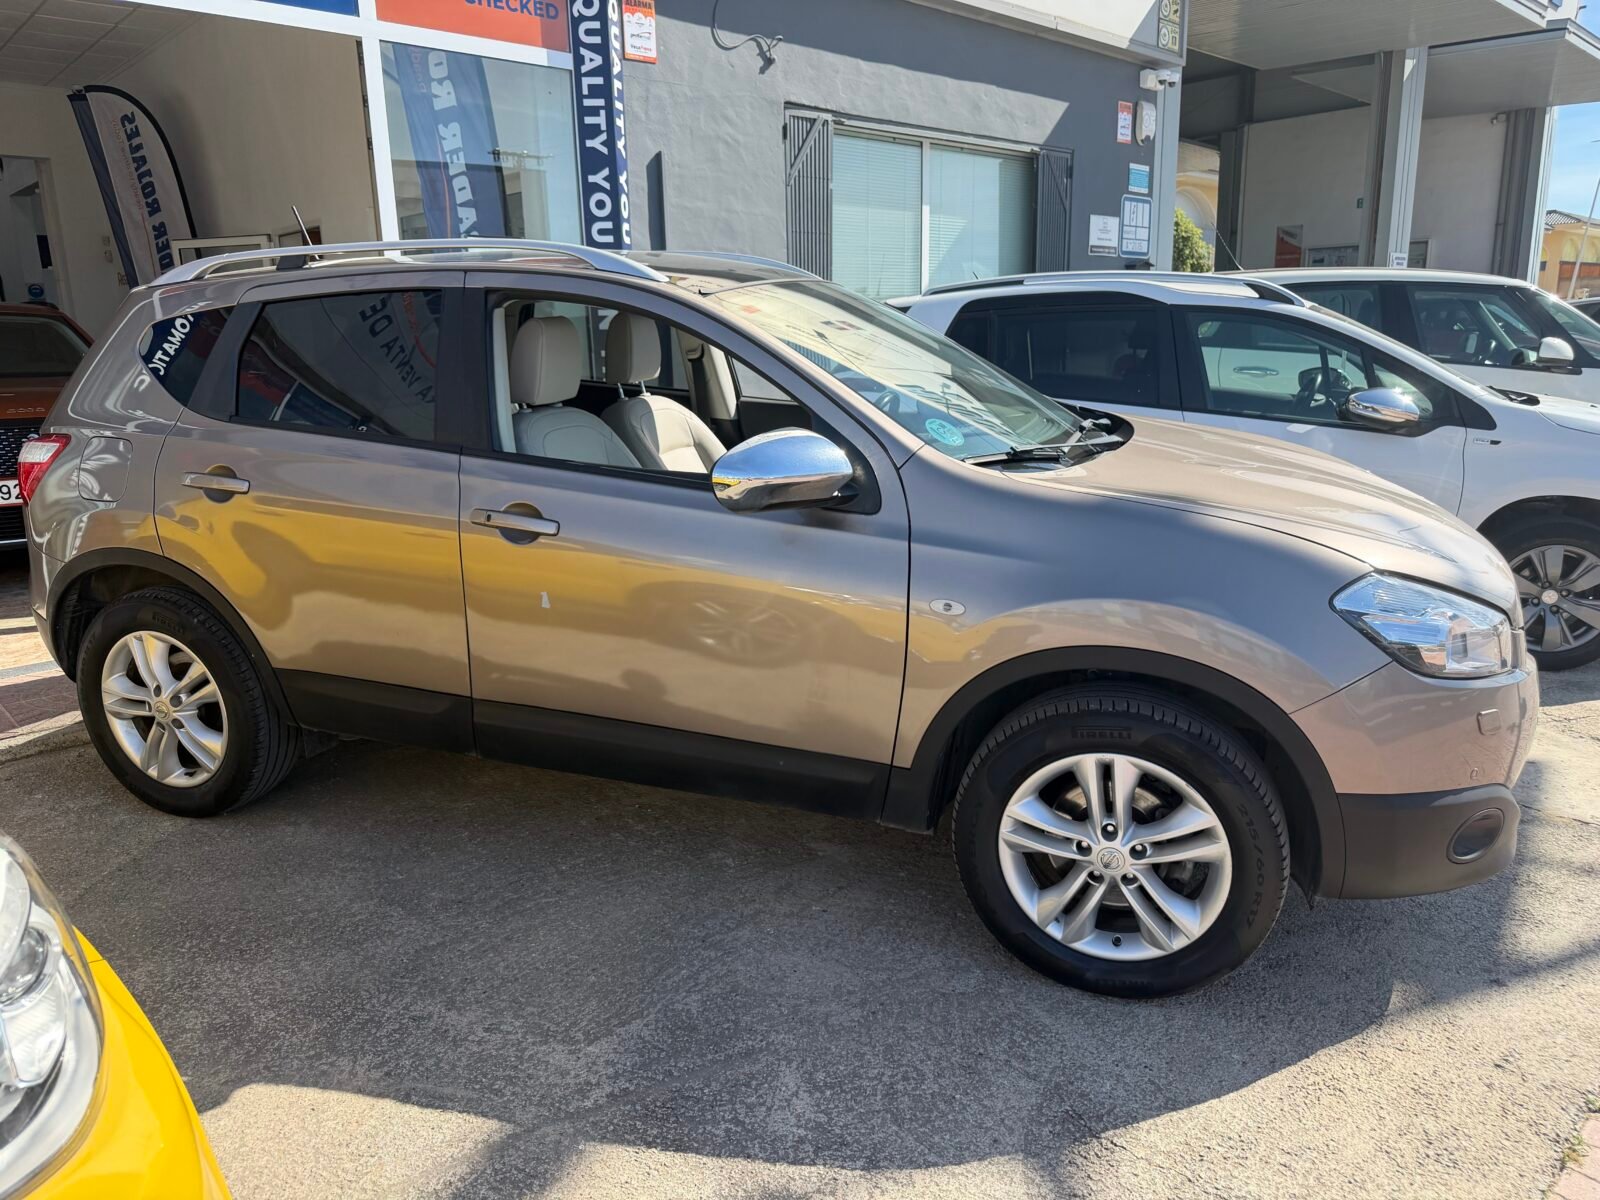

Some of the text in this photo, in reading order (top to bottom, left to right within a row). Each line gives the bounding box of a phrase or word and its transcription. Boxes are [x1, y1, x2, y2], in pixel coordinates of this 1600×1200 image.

[572, 0, 614, 243] QUALITY YOU
[608, 0, 631, 244] QUALITY YOU
[1072, 726, 1132, 740] PIRELLI
